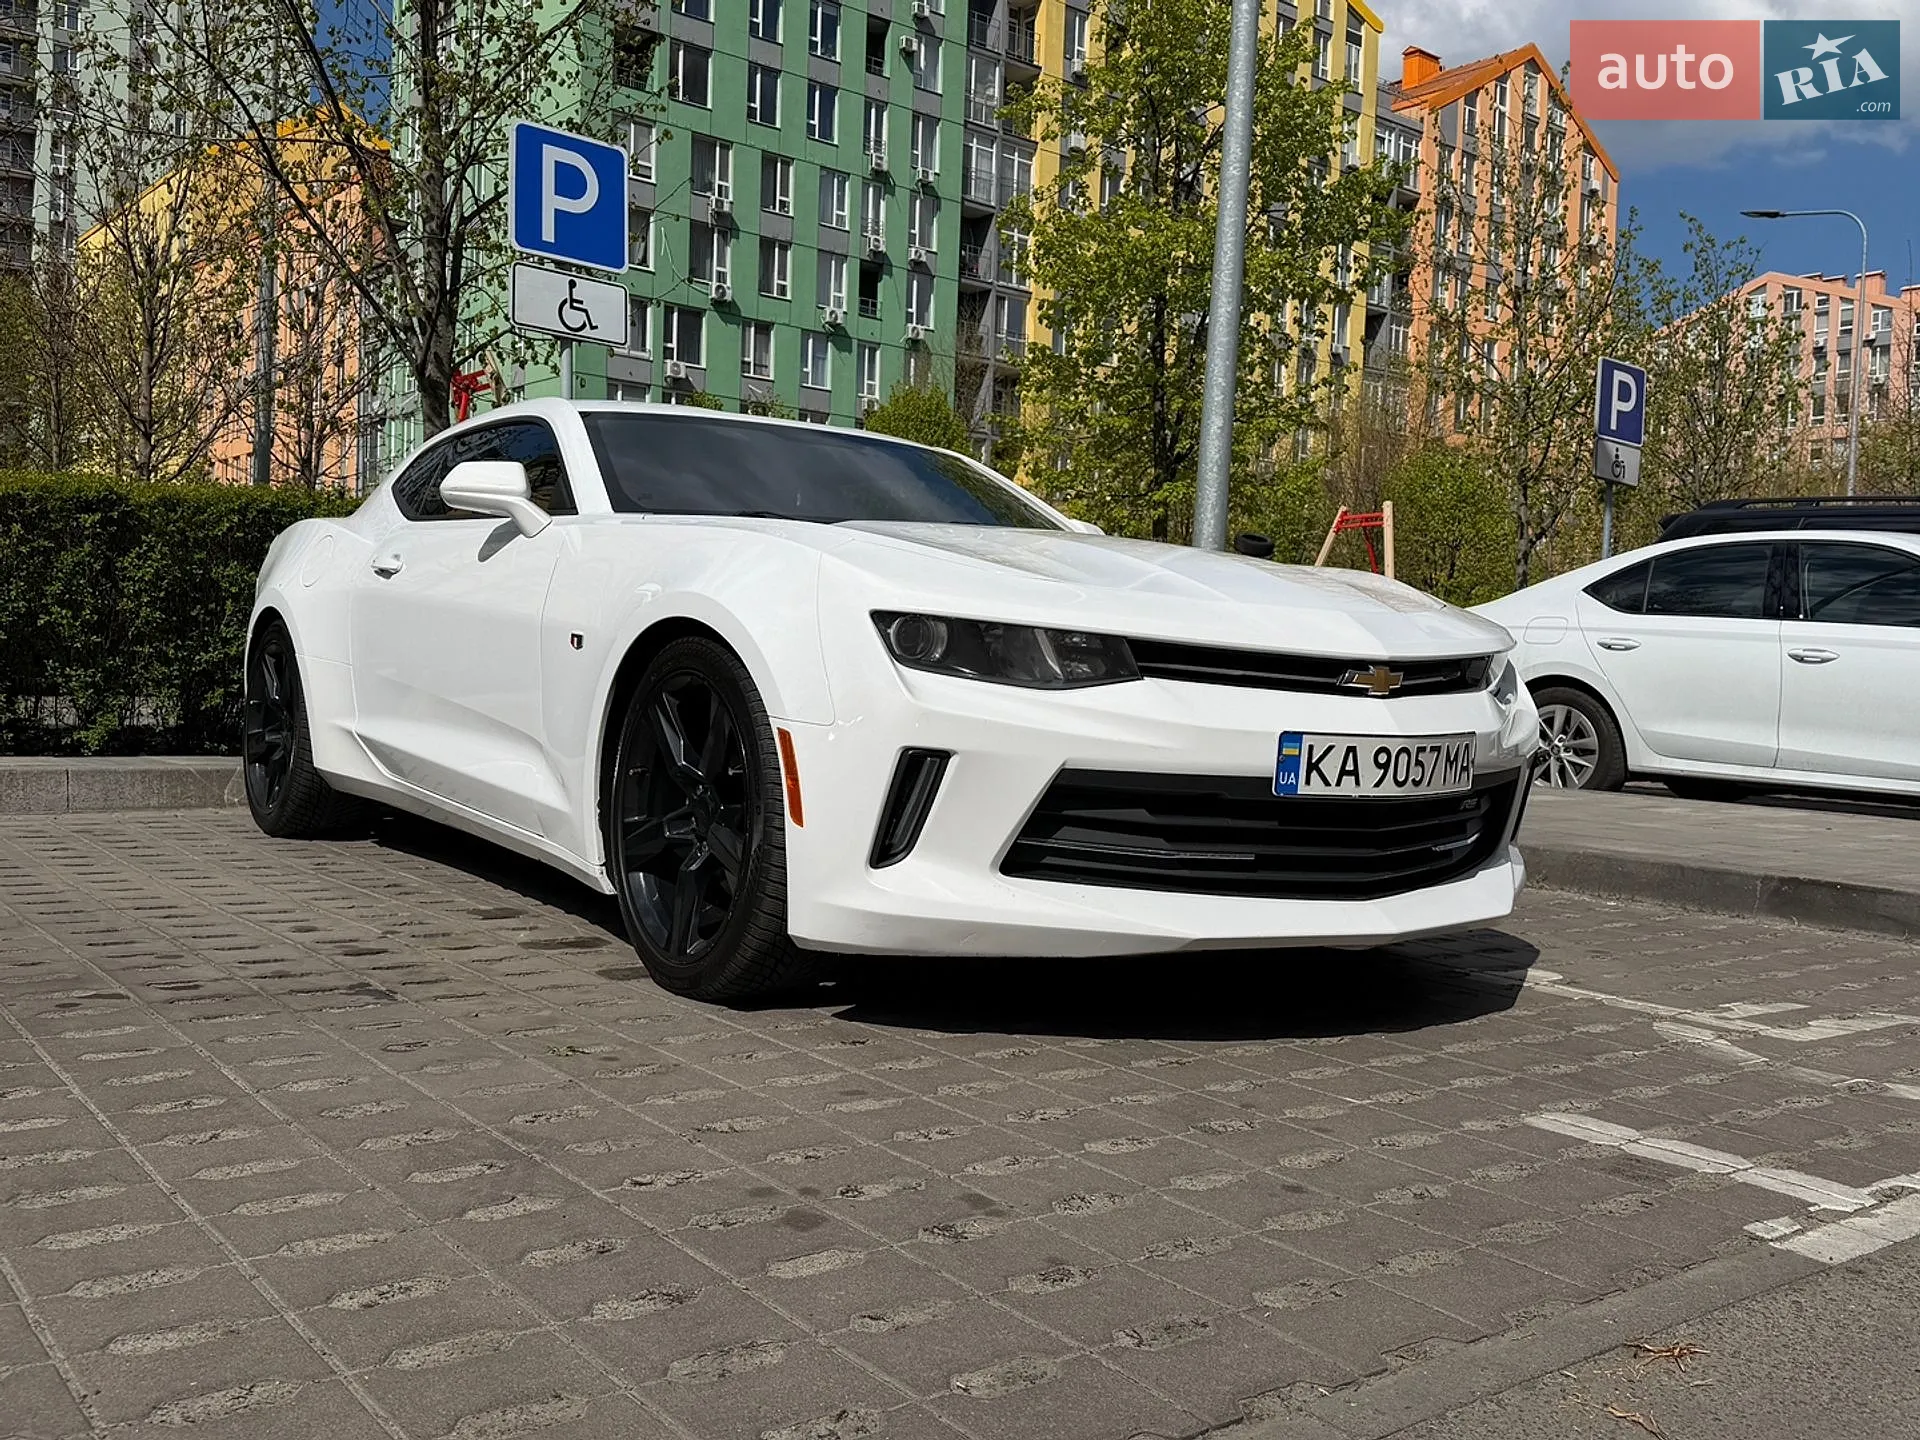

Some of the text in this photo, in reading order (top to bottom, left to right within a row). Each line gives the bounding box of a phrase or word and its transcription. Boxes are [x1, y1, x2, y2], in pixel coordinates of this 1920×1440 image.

[542, 143, 599, 243] P
[1610, 369, 1637, 431] P
[1279, 772, 1297, 785] UA
[1304, 742, 1471, 788] KA 9057 MA
